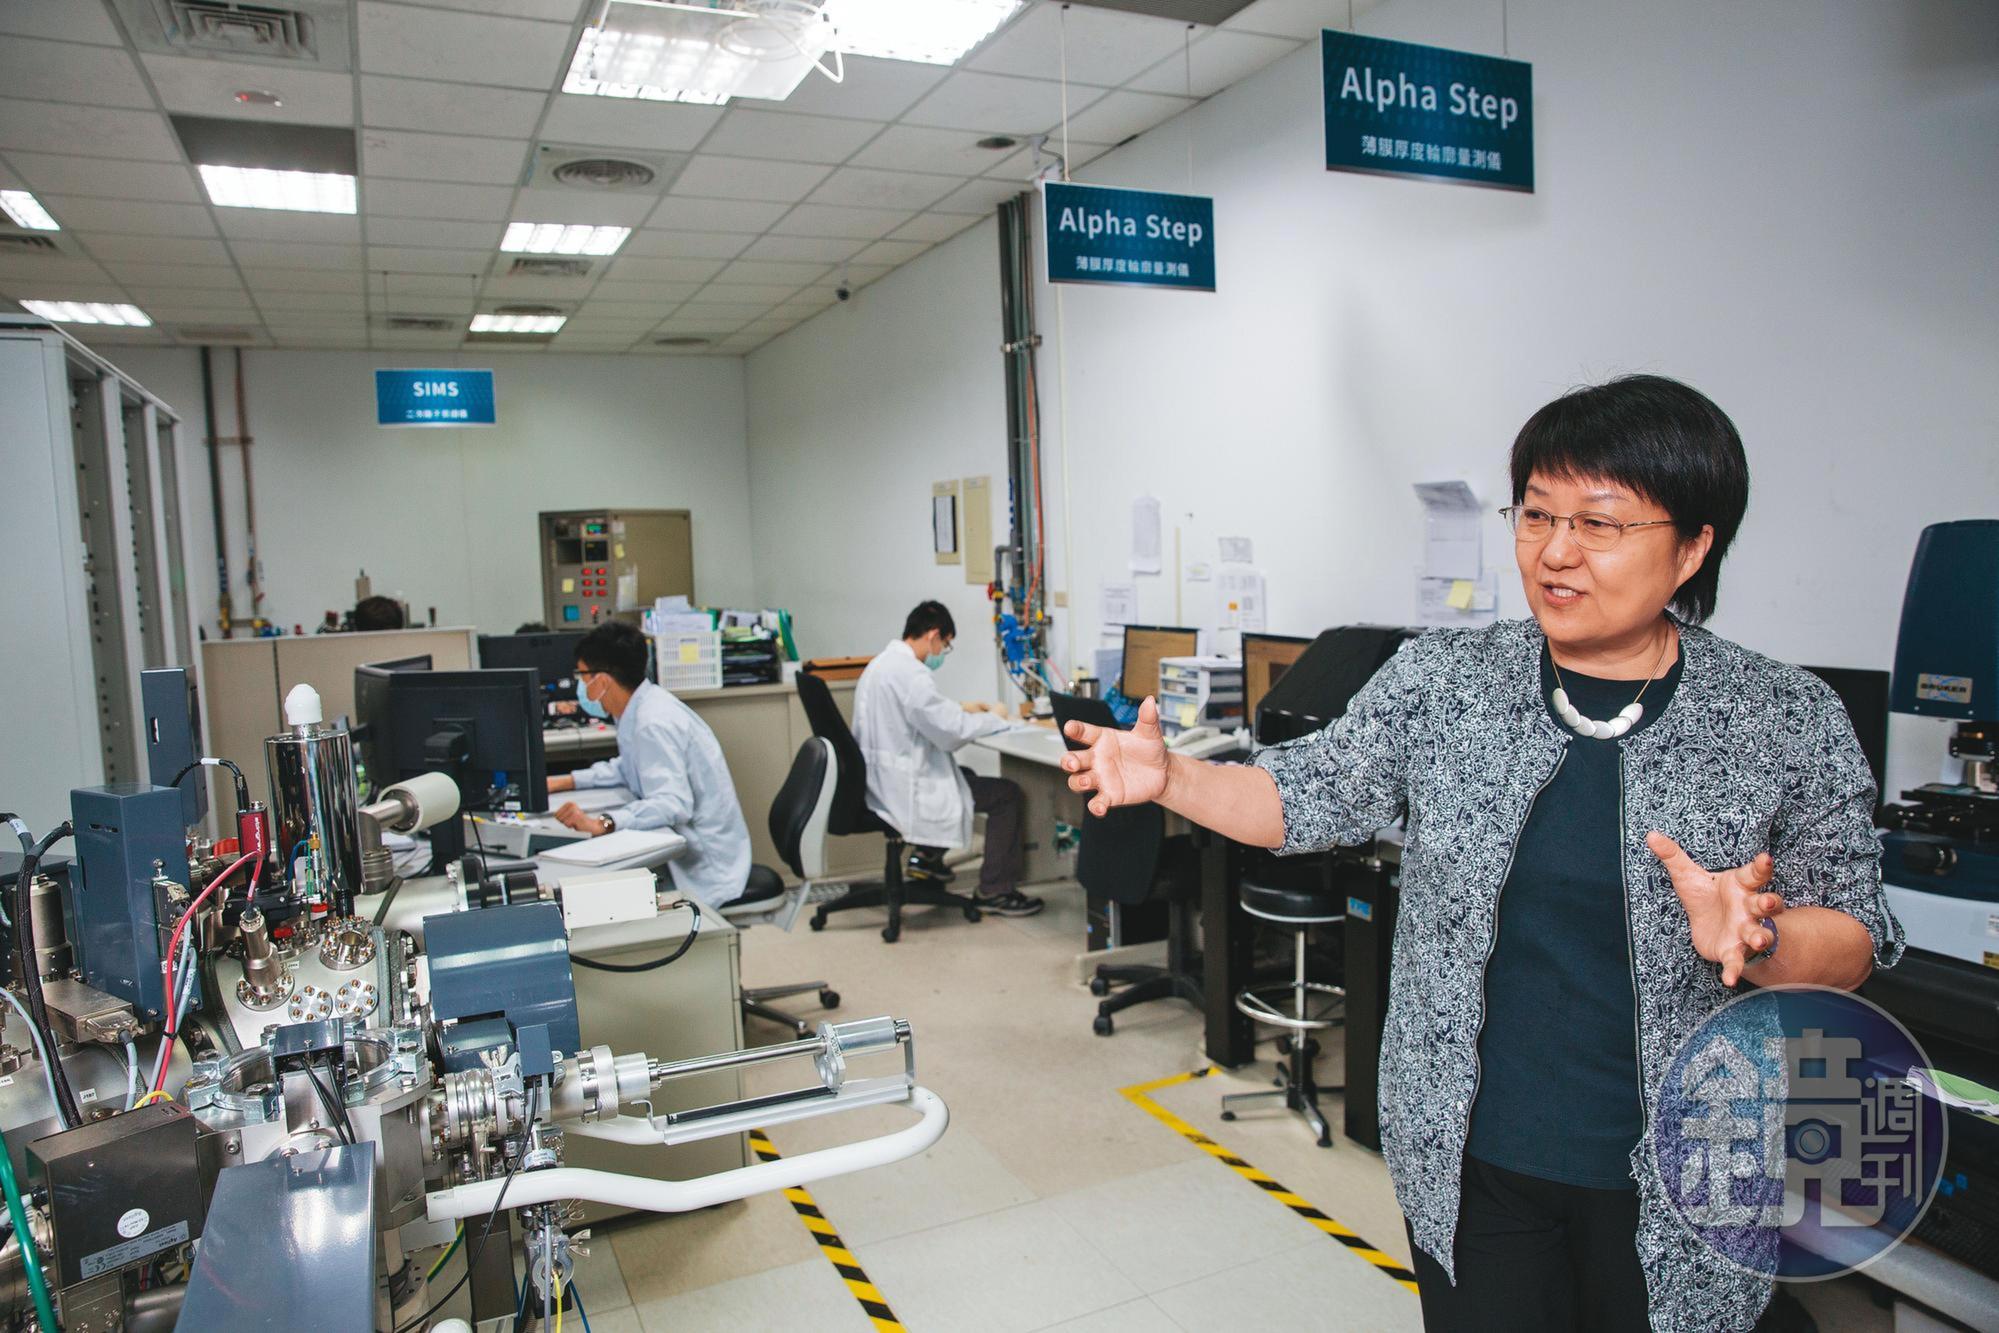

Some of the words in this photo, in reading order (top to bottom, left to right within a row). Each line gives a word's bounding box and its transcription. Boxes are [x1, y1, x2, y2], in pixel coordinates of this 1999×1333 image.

[1341, 66, 1437, 113] Alpha
[1449, 82, 1518, 130] Step
[1361, 135, 1502, 171] 薄膜厚度輪廓量測儀
[1059, 206, 1136, 240] Alpha
[1146, 214, 1203, 247] Step
[412, 381, 460, 397] SIMS
